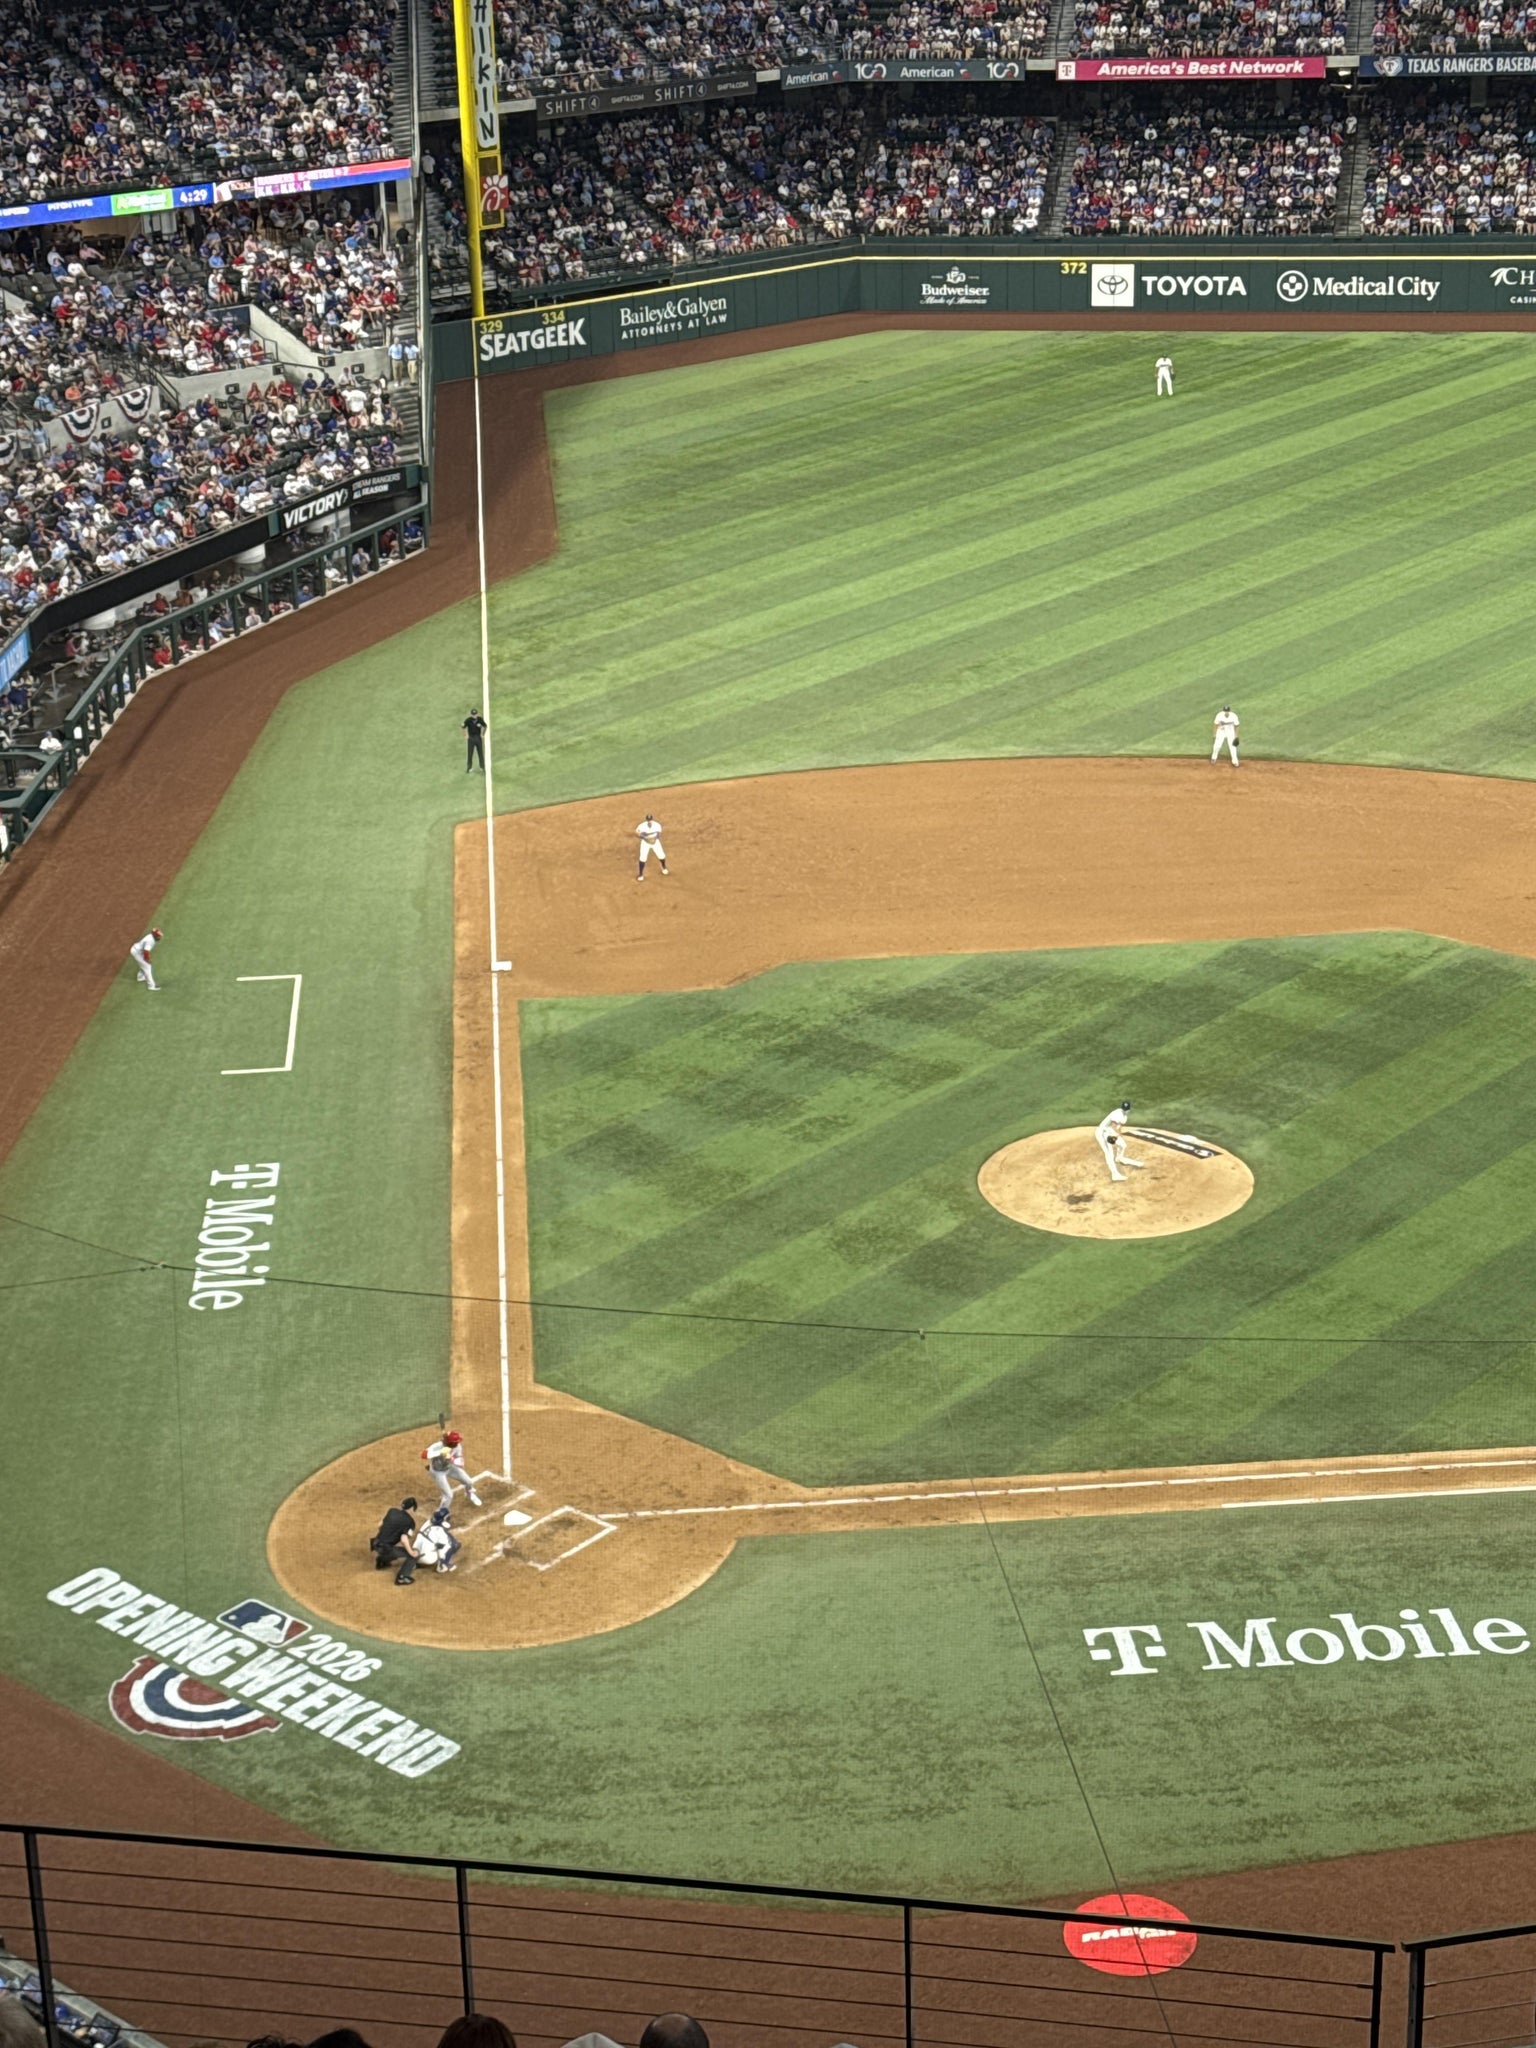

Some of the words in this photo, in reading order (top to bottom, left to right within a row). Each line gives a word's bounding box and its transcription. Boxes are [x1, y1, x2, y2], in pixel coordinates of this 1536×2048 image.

[900, 66, 954, 78] American
[1097, 61, 1184, 76] America's
[1187, 61, 1227, 75] Best
[1229, 60, 1304, 74] Network
[1407, 58, 1441, 73] TEXAS
[1443, 57, 1494, 72] RANGERS
[785, 70, 829, 85] American
[654, 84, 694, 101] SHIFT
[545, 97, 586, 115] SHIFT
[179, 188, 208, 203] 4:29
[1060, 262, 1088, 275] 372
[921, 283, 990, 296] Budweiser
[1141, 275, 1247, 296] TOYOTA
[1312, 276, 1394, 296] Medical
[1397, 276, 1440, 301] City
[480, 320, 503, 334] 329
[542, 312, 565, 325] 334
[621, 322, 682, 340] ATTORNEYS
[687, 318, 700, 329] AT
[706, 314, 728, 326] LAW
[479, 318, 587, 361] SEATGEEK
[210, 1162, 280, 1189] T
[188, 1195, 276, 1310] Mobile
[1082, 1624, 1167, 1676] T
[1186, 1607, 1531, 1671] Mobile
[286, 1634, 383, 1683] 2026
[46, 1567, 258, 1677] OPENING
[219, 1648, 462, 1779] WEEKEND
